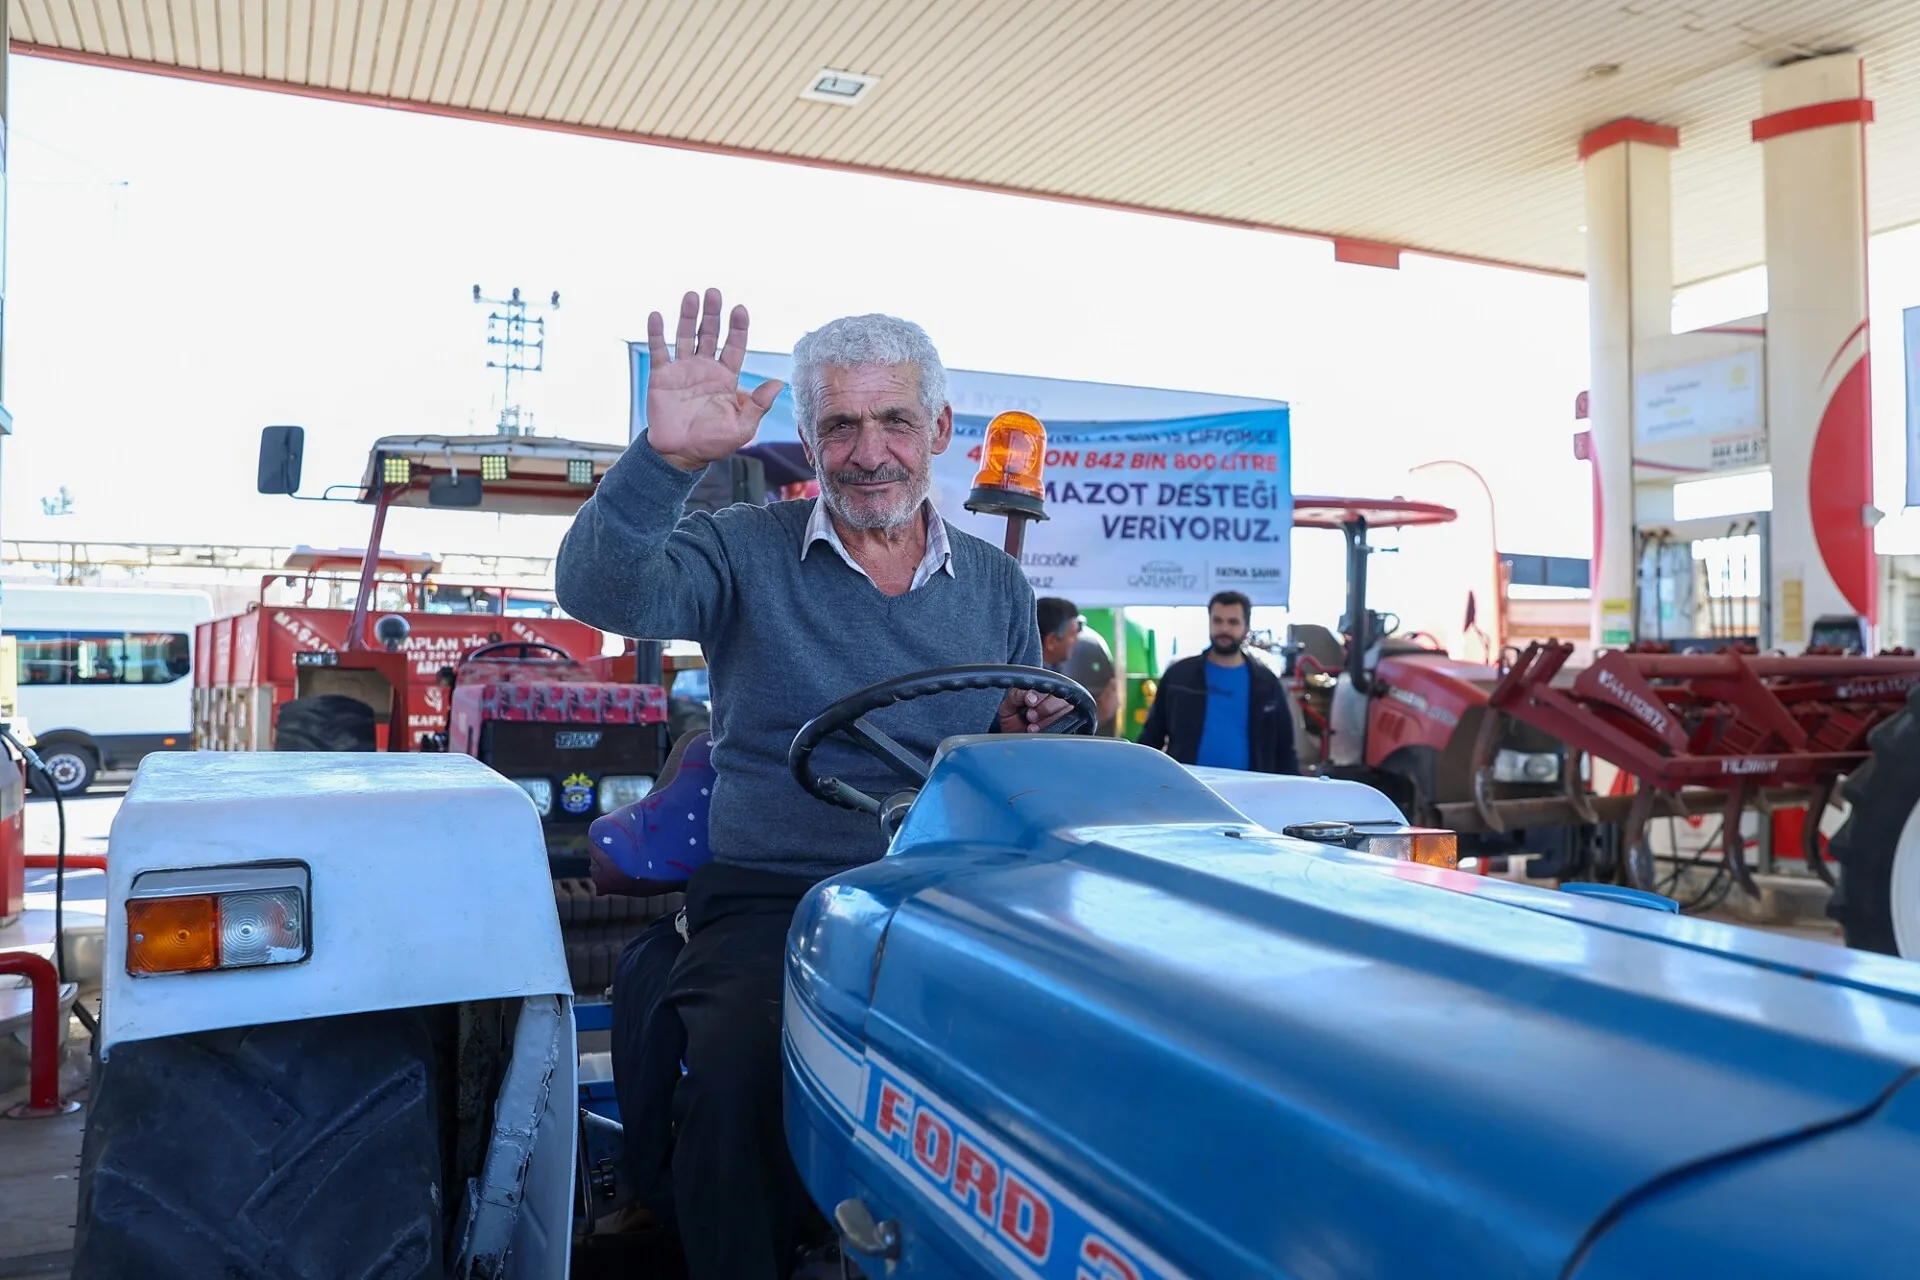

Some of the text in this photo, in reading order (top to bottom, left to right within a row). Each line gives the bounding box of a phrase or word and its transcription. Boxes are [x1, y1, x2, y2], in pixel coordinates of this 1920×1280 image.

[1085, 451, 1125, 469] 842
[1173, 453, 1216, 470] 800
[1157, 479, 1278, 509] DESTEĞİ
[1101, 514, 1280, 542] VERİYORUZ.
[876, 1077, 1053, 1266] FORD
